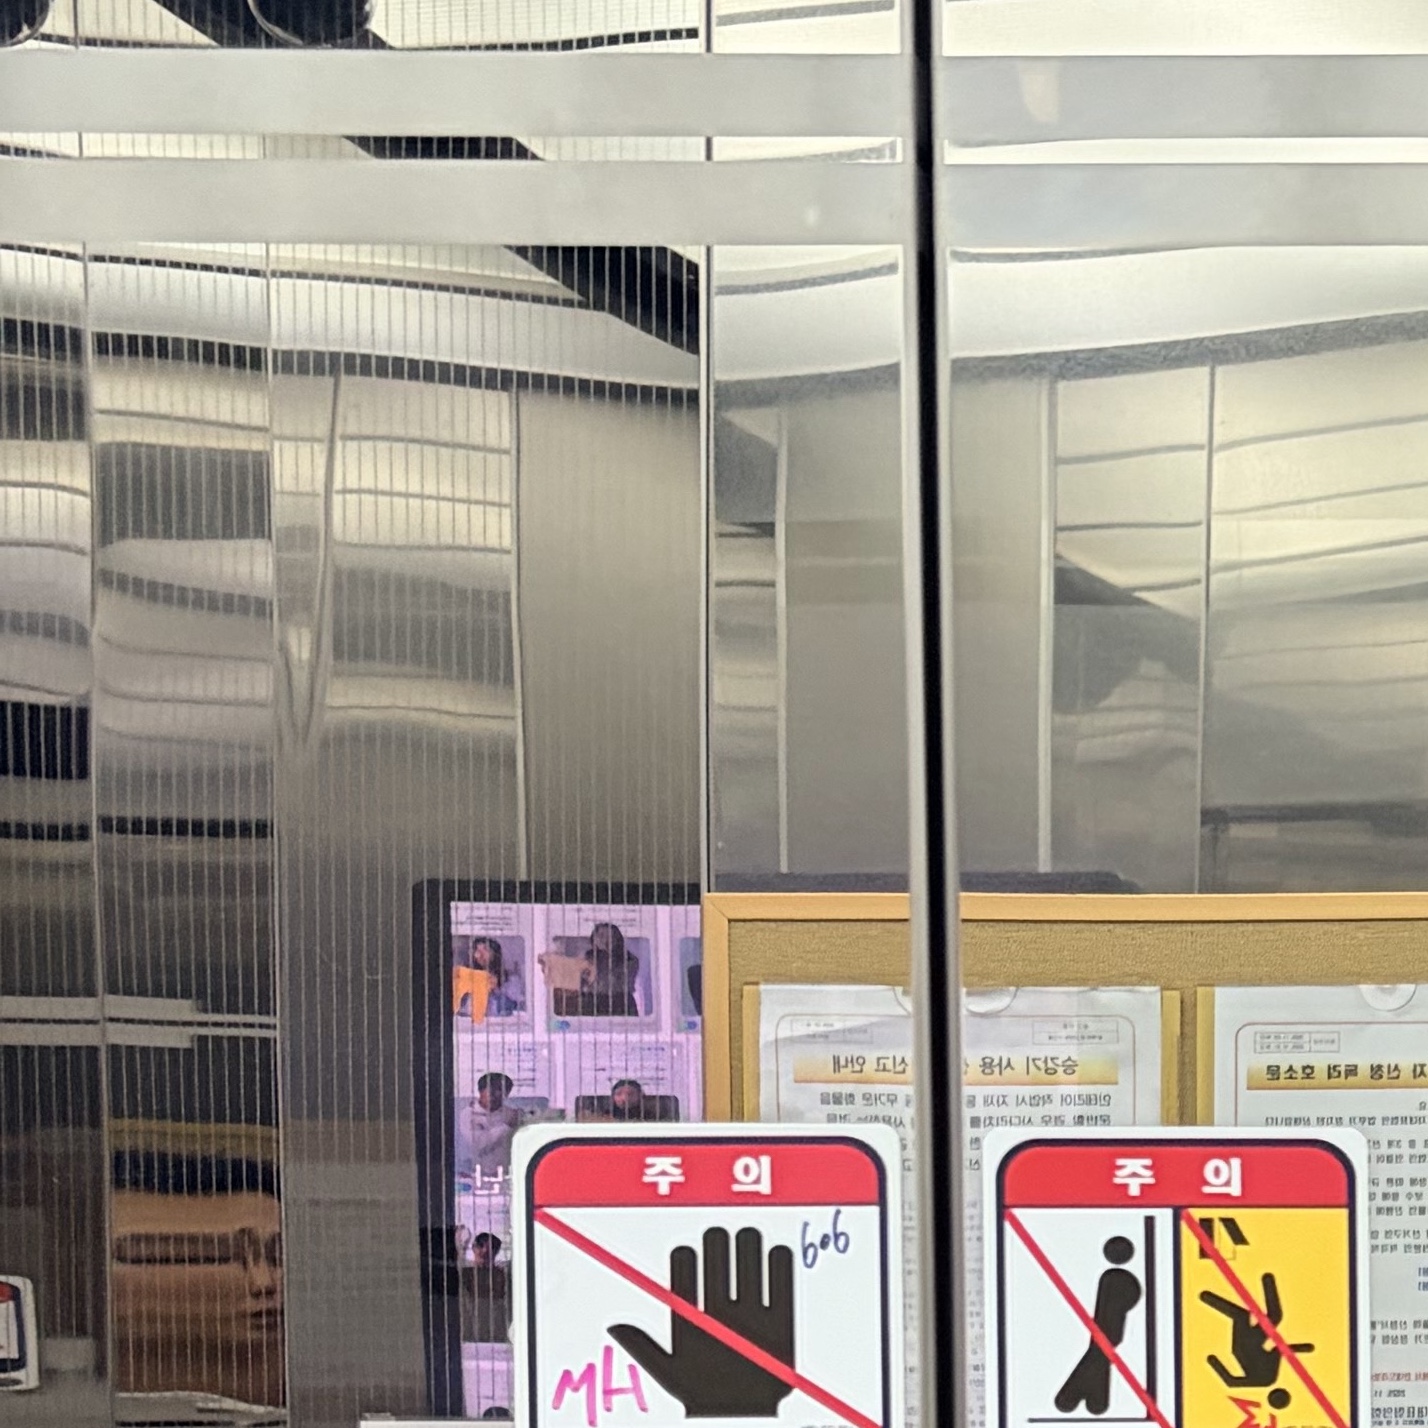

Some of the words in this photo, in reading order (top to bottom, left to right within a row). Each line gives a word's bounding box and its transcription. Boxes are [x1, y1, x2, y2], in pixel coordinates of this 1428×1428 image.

[642, 1155, 686, 1195] 주
[731, 1154, 773, 1195] 의
[1112, 1160, 1157, 1198] 주
[1203, 1157, 1243, 1197] 의
